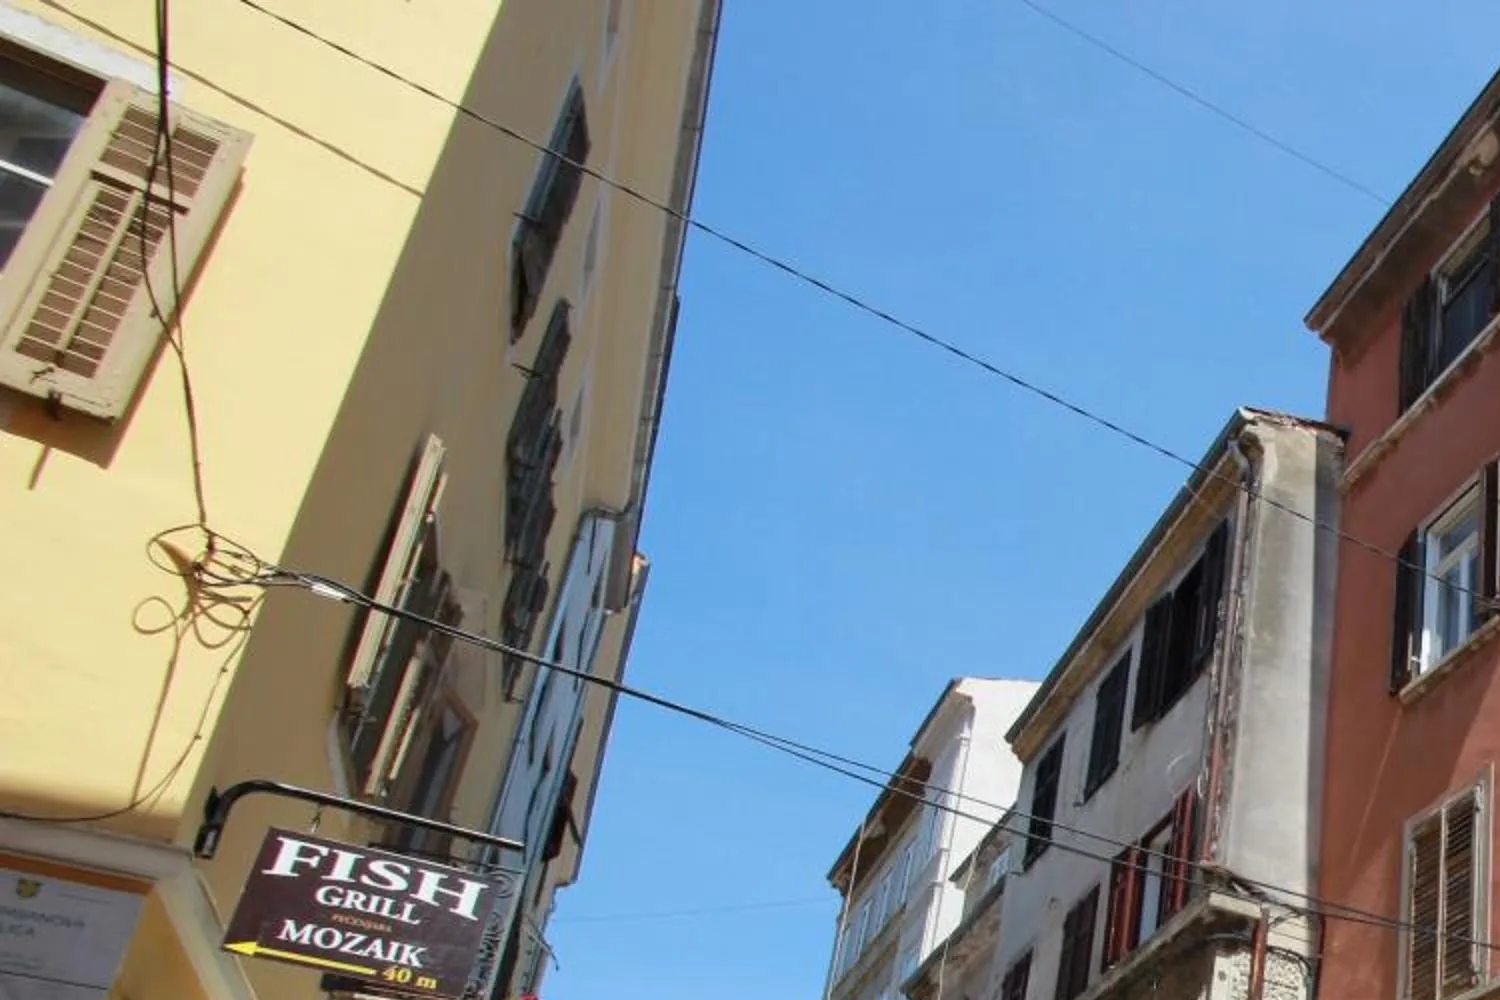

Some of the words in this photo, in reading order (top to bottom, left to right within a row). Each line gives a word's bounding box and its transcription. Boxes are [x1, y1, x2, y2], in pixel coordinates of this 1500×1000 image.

[262, 837, 489, 921] FISH
[315, 885, 421, 925] GRILL
[277, 919, 428, 968] MOZAIK
[383, 965, 411, 984] 40
[416, 975, 438, 990] m
